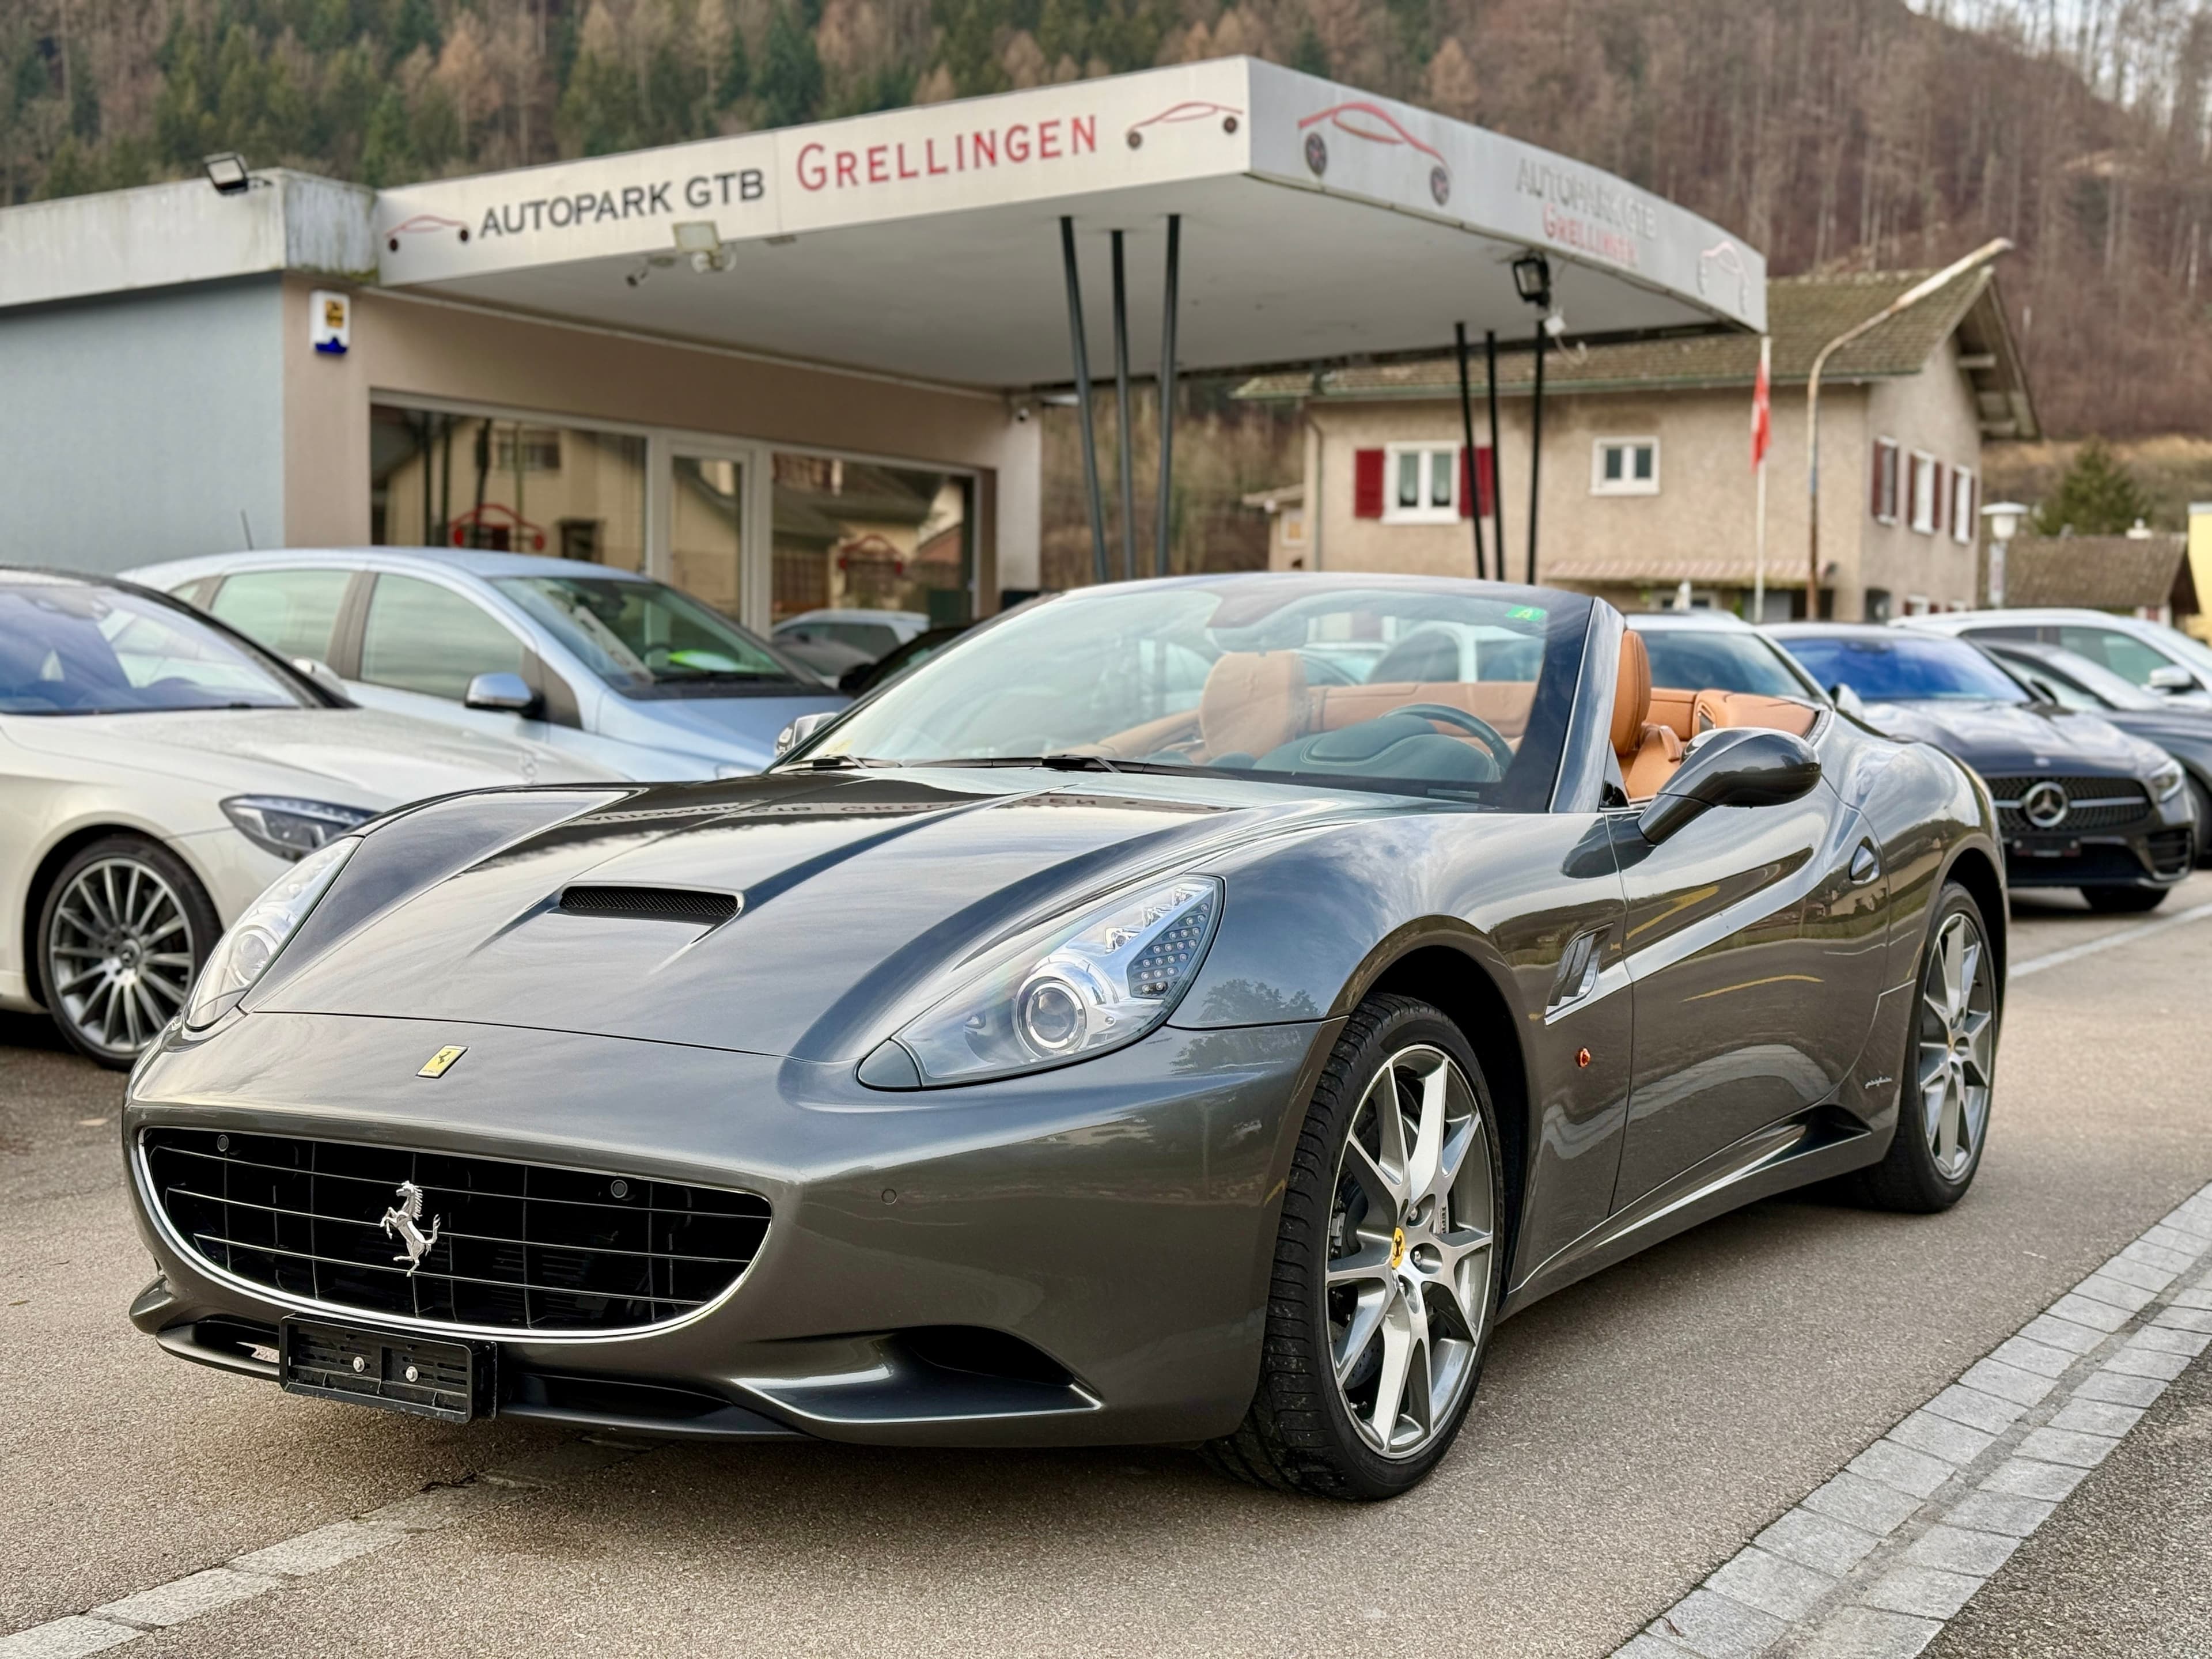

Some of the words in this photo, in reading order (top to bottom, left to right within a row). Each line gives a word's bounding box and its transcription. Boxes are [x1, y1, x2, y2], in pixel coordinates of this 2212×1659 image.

[797, 115, 1097, 192] GRELLINGEN
[478, 182, 673, 238] AUTOPARK
[685, 169, 765, 209] GTB
